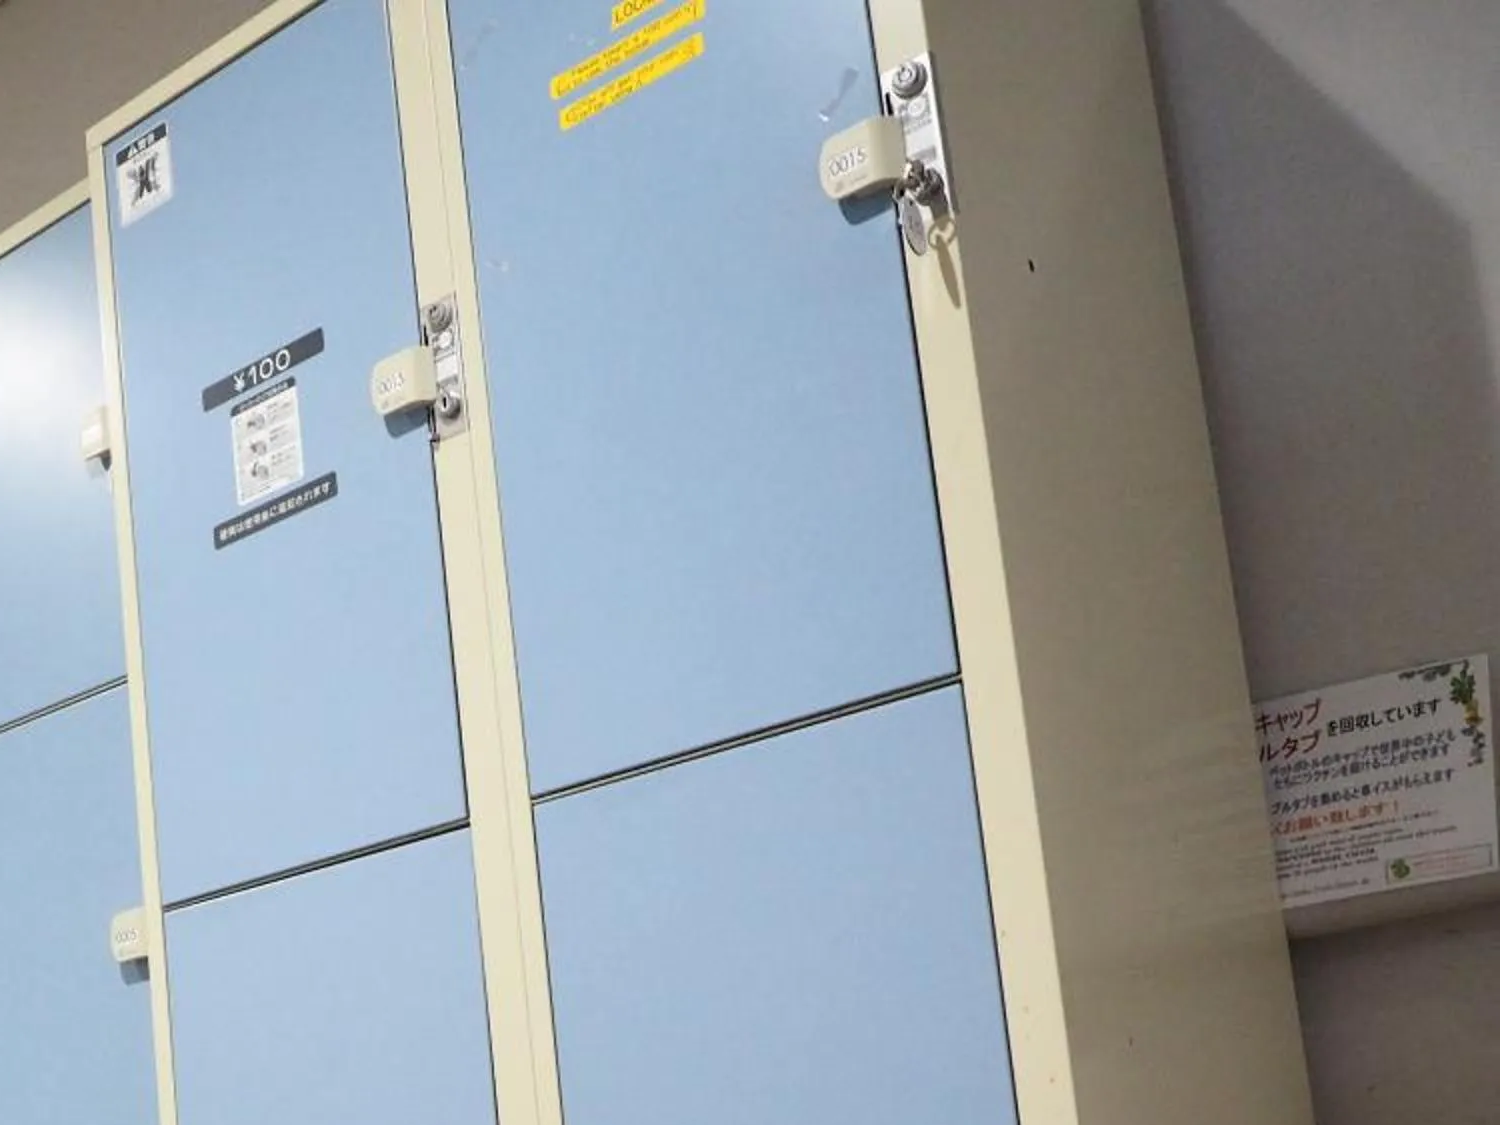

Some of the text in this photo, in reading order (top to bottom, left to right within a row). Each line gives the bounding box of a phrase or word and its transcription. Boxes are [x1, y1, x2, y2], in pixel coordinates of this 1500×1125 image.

[828, 147, 867, 178] 0015
[232, 348, 291, 392] ¥100
[1327, 698, 1441, 737] を回収しています
